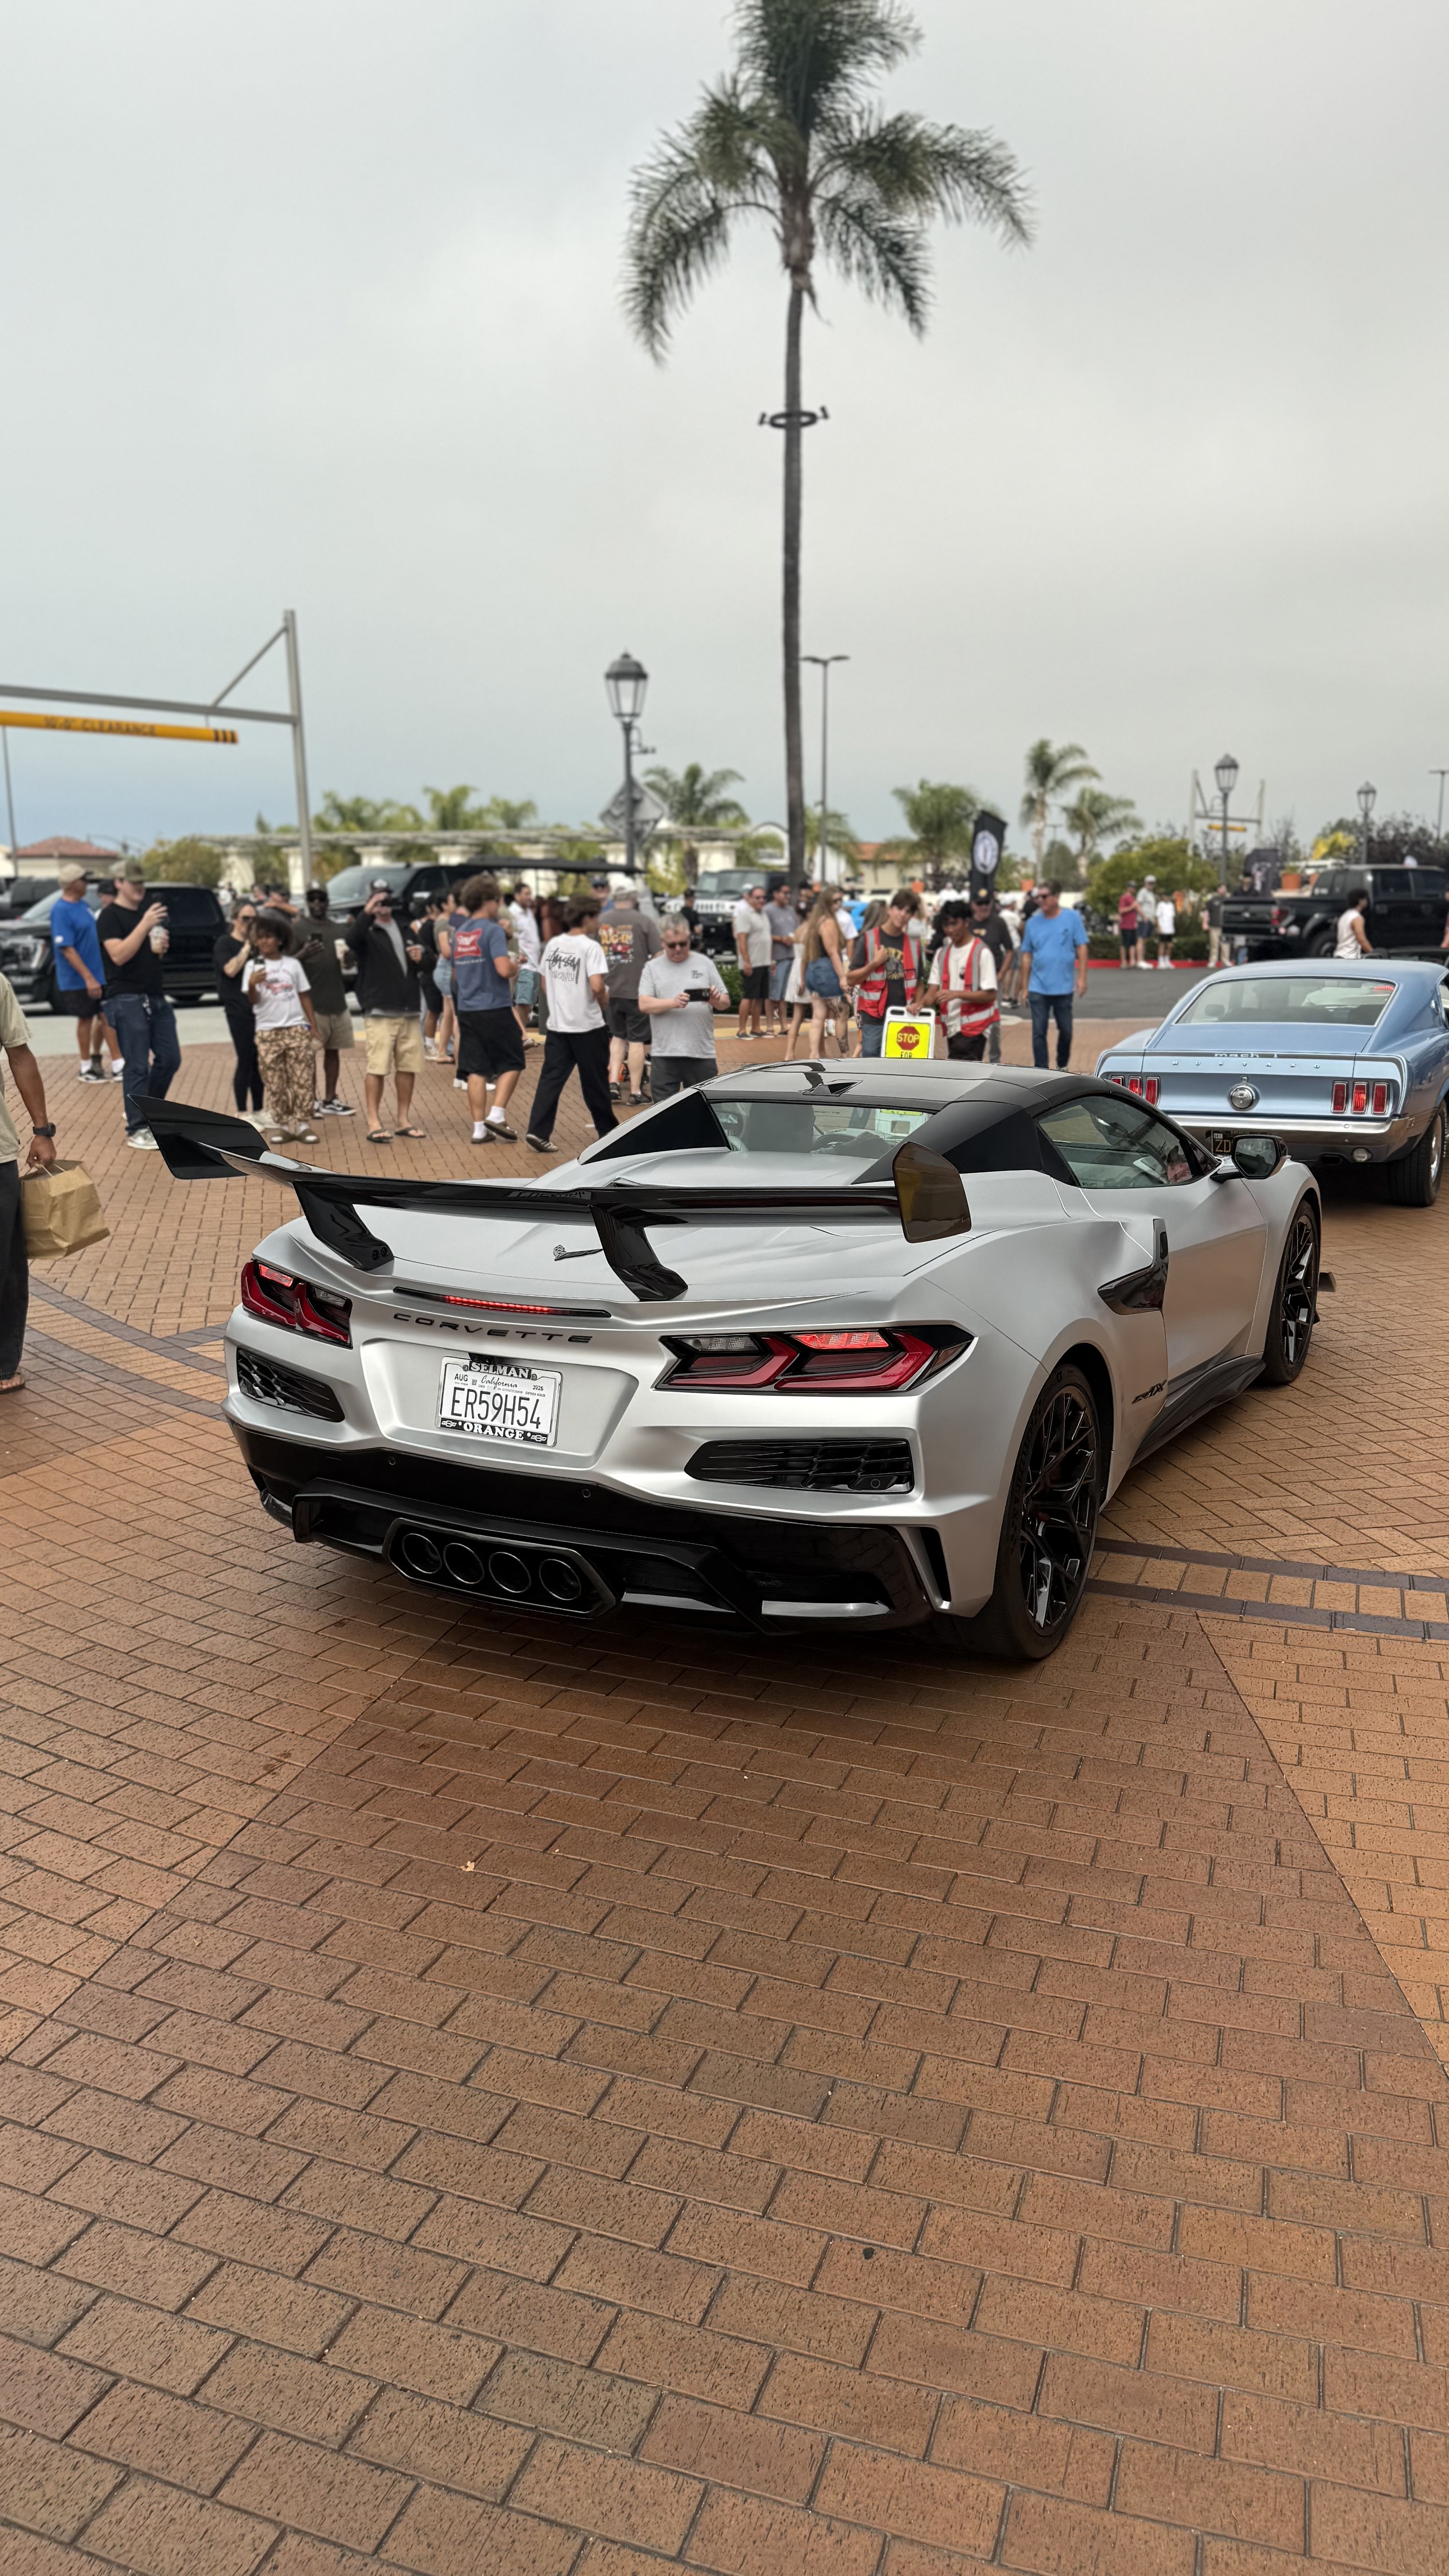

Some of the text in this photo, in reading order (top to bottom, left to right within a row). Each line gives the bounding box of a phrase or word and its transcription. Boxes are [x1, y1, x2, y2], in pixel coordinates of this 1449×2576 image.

[82, 719, 156, 736] CLEARANCE
[897, 1033, 920, 1043] STOP
[1172, 1061, 1320, 1069] MUSTANG
[393, 1313, 593, 1343] CORVETTE
[454, 1373, 468, 1382] AUG
[470, 1362, 529, 1379] SELMAN
[481, 1375, 518, 1389] California
[451, 1387, 541, 1429] ER59H54
[463, 1422, 524, 1440] ORANGE
